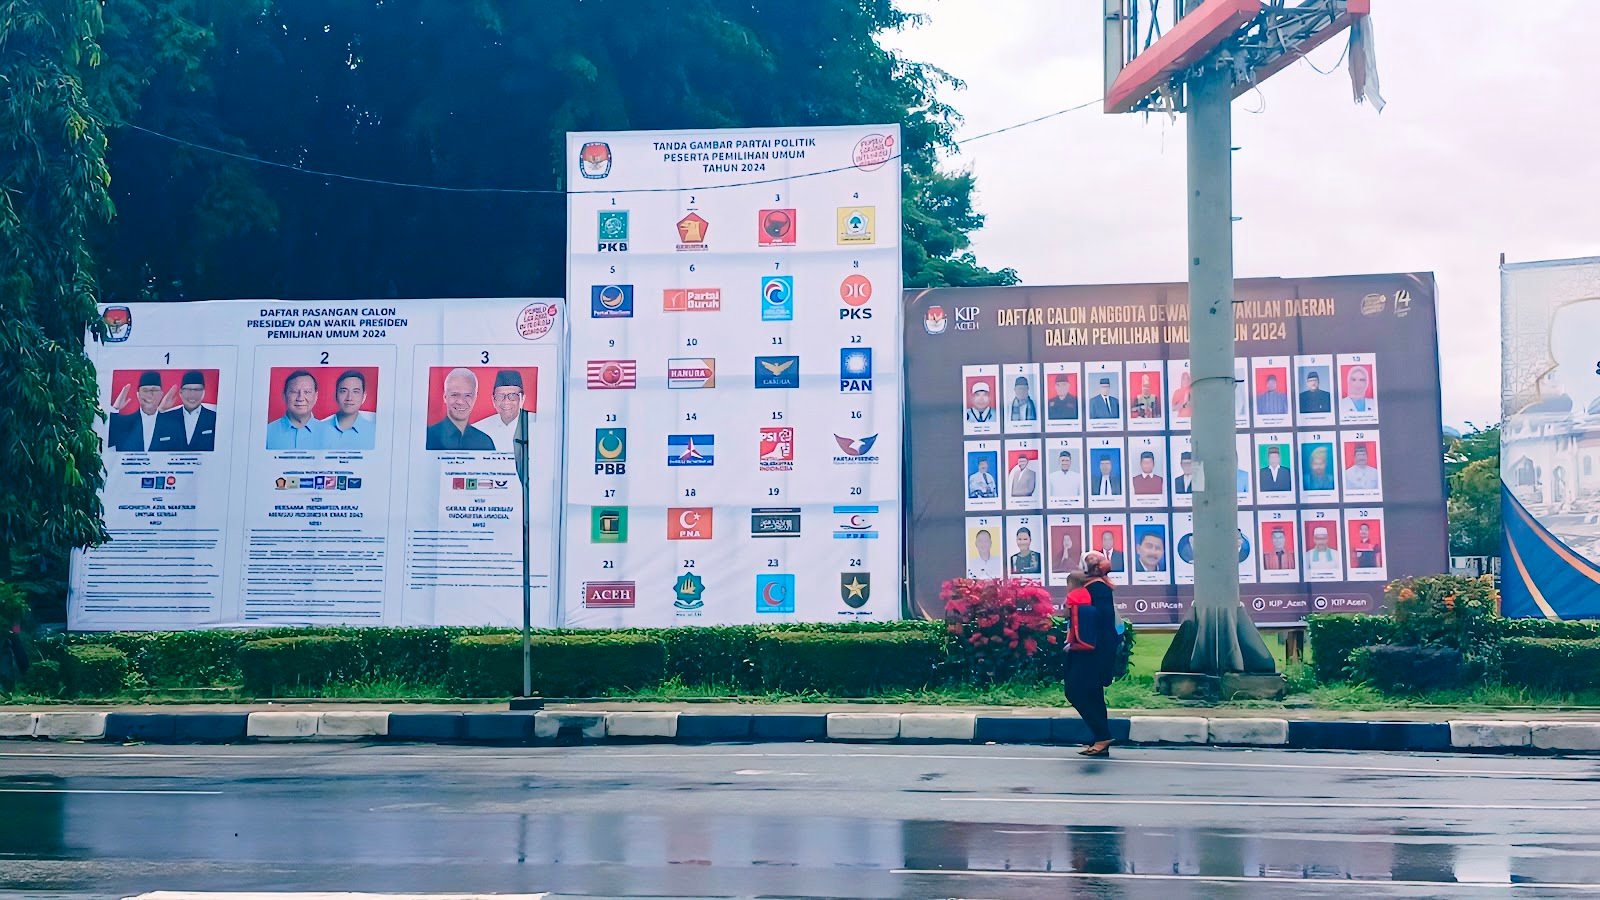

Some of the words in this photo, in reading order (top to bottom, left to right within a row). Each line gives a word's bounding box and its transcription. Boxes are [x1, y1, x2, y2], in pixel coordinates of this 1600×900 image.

[653, 142, 687, 151] TANDA
[690, 141, 733, 150] GAMBAR
[736, 140, 771, 149] PARTAI
[774, 138, 816, 148] POLITIK
[664, 153, 709, 162] PESERTA
[712, 152, 769, 161] PEMILIHAN
[772, 150, 805, 159] UMUM
[703, 164, 738, 173] TAHUN
[741, 163, 766, 172] 2024
[690, 196, 695, 204] 2
[598, 243, 628, 252] PKB
[610, 266, 616, 274] 5
[690, 264, 695, 272] 6
[775, 262, 780, 270] 7
[260, 309, 299, 317] DAFTAR
[302, 308, 358, 316] PASANGAN
[362, 308, 396, 316] CALON
[840, 308, 872, 320] PKS
[955, 306, 980, 321] KIP
[998, 308, 1044, 326] DAFTAR
[1047, 306, 1086, 324] CALON
[1090, 304, 1146, 323] ANGGOTA
[1150, 304, 1190, 322] DEWA
[1286, 298, 1334, 317] DAERAH
[247, 320, 295, 328] PRESIDEN
[324, 319, 356, 327] WAKIL
[359, 319, 408, 327] PRESIDEN
[267, 330, 323, 339] PEMILIHAN
[326, 330, 359, 338] UMUM
[363, 330, 386, 338] 2024
[1046, 328, 1088, 347] DALAM
[1092, 326, 1159, 345] PEMILIHAN
[1164, 326, 1190, 344] UMU
[1252, 322, 1286, 341] 2024
[164, 352, 170, 364] 1
[320, 352, 329, 364] 2
[481, 350, 490, 364] 3
[840, 380, 872, 392] PAN
[606, 414, 617, 422] 13
[686, 413, 697, 421] 14
[772, 412, 783, 420] 15
[851, 411, 862, 419] 16
[760, 432, 777, 442] PSI
[595, 464, 626, 475] PBB
[605, 490, 616, 498] 17
[685, 489, 696, 497] 18
[768, 488, 780, 496] 19
[850, 487, 862, 495] 20
[603, 560, 614, 569] 21
[684, 560, 695, 568] 22
[768, 559, 779, 567] 23
[850, 559, 861, 567] 24
[591, 590, 631, 600] ACEH
